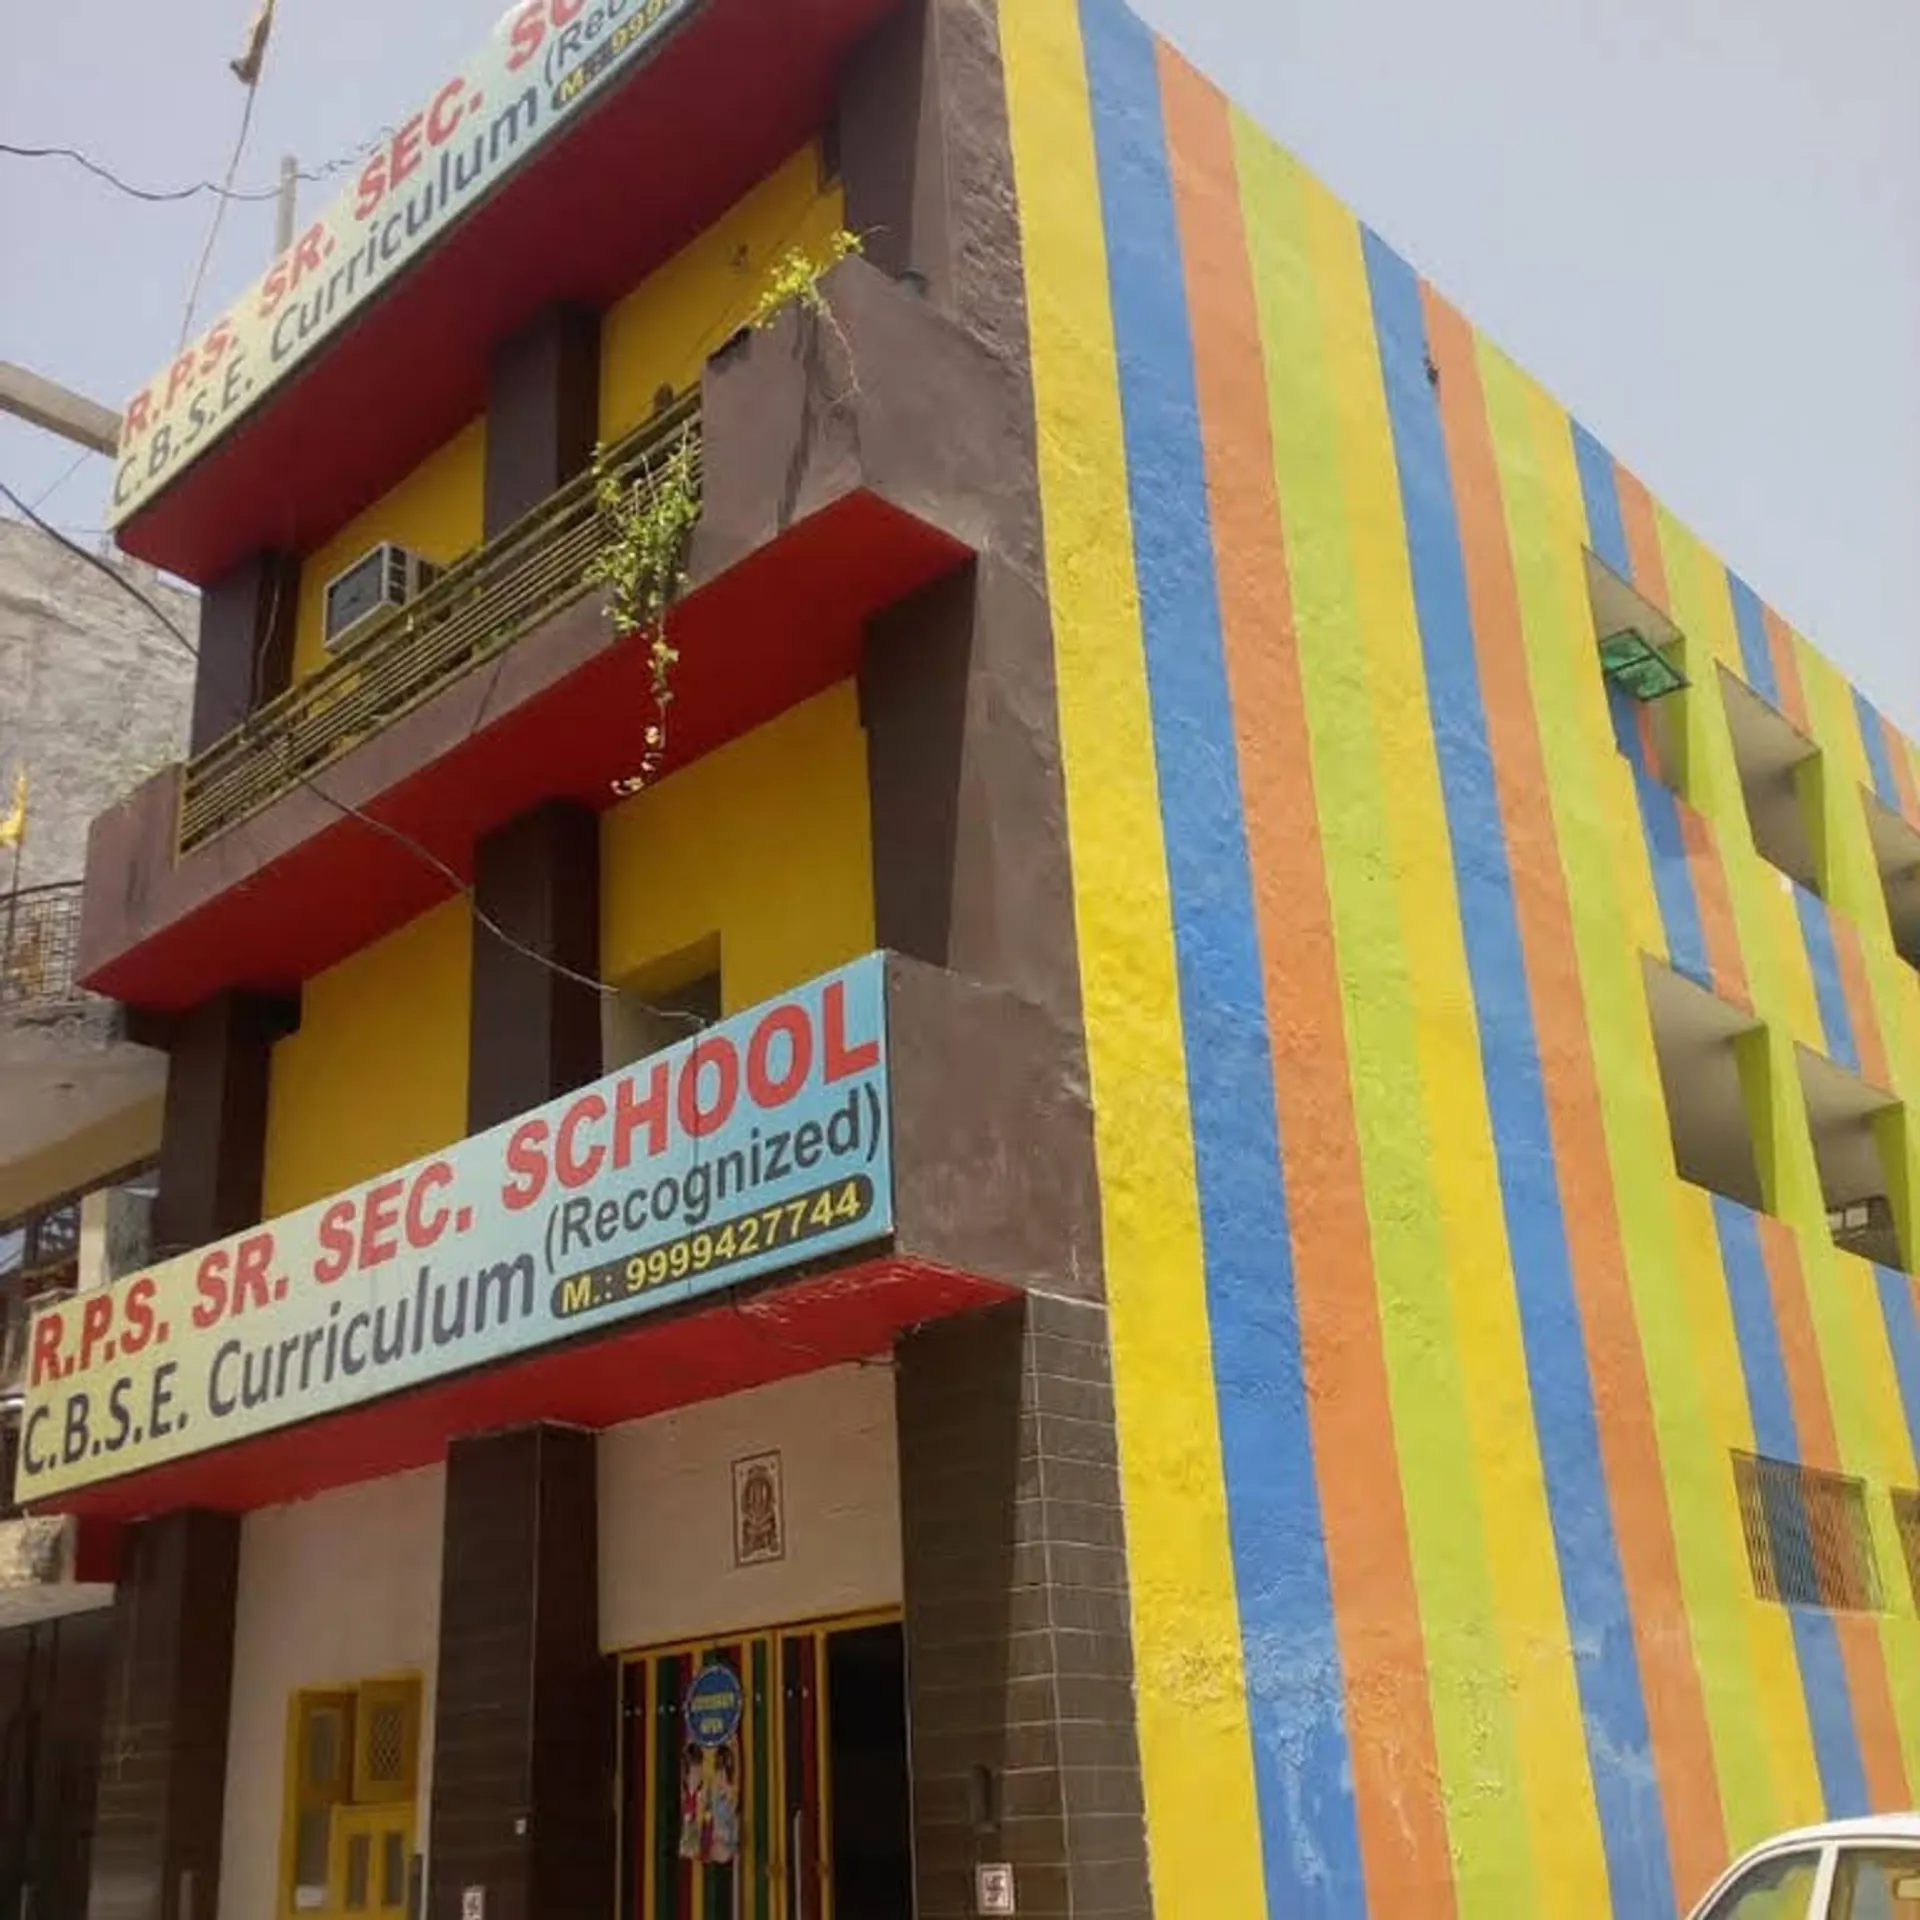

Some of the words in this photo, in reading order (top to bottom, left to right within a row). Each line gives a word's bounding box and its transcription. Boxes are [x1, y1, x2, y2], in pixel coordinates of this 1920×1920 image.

[114, 352, 253, 507] C.B.S.E.
[271, 86, 537, 362] Curriculum
[122, 318, 239, 449] R.P.S.
[258, 222, 336, 318] SR.
[355, 77, 483, 221] SEC.
[23, 1362, 189, 1475] C.B.S.E.
[208, 1253, 535, 1417] Curriculum
[545, 1081, 882, 1274] (Recognized)
[31, 1278, 170, 1388] R.P.S.
[192, 1232, 289, 1328] SR.
[313, 1160, 473, 1284] SEC.
[502, 979, 880, 1210] SCHOOL
[626, 1182, 863, 1293] 9999427744
